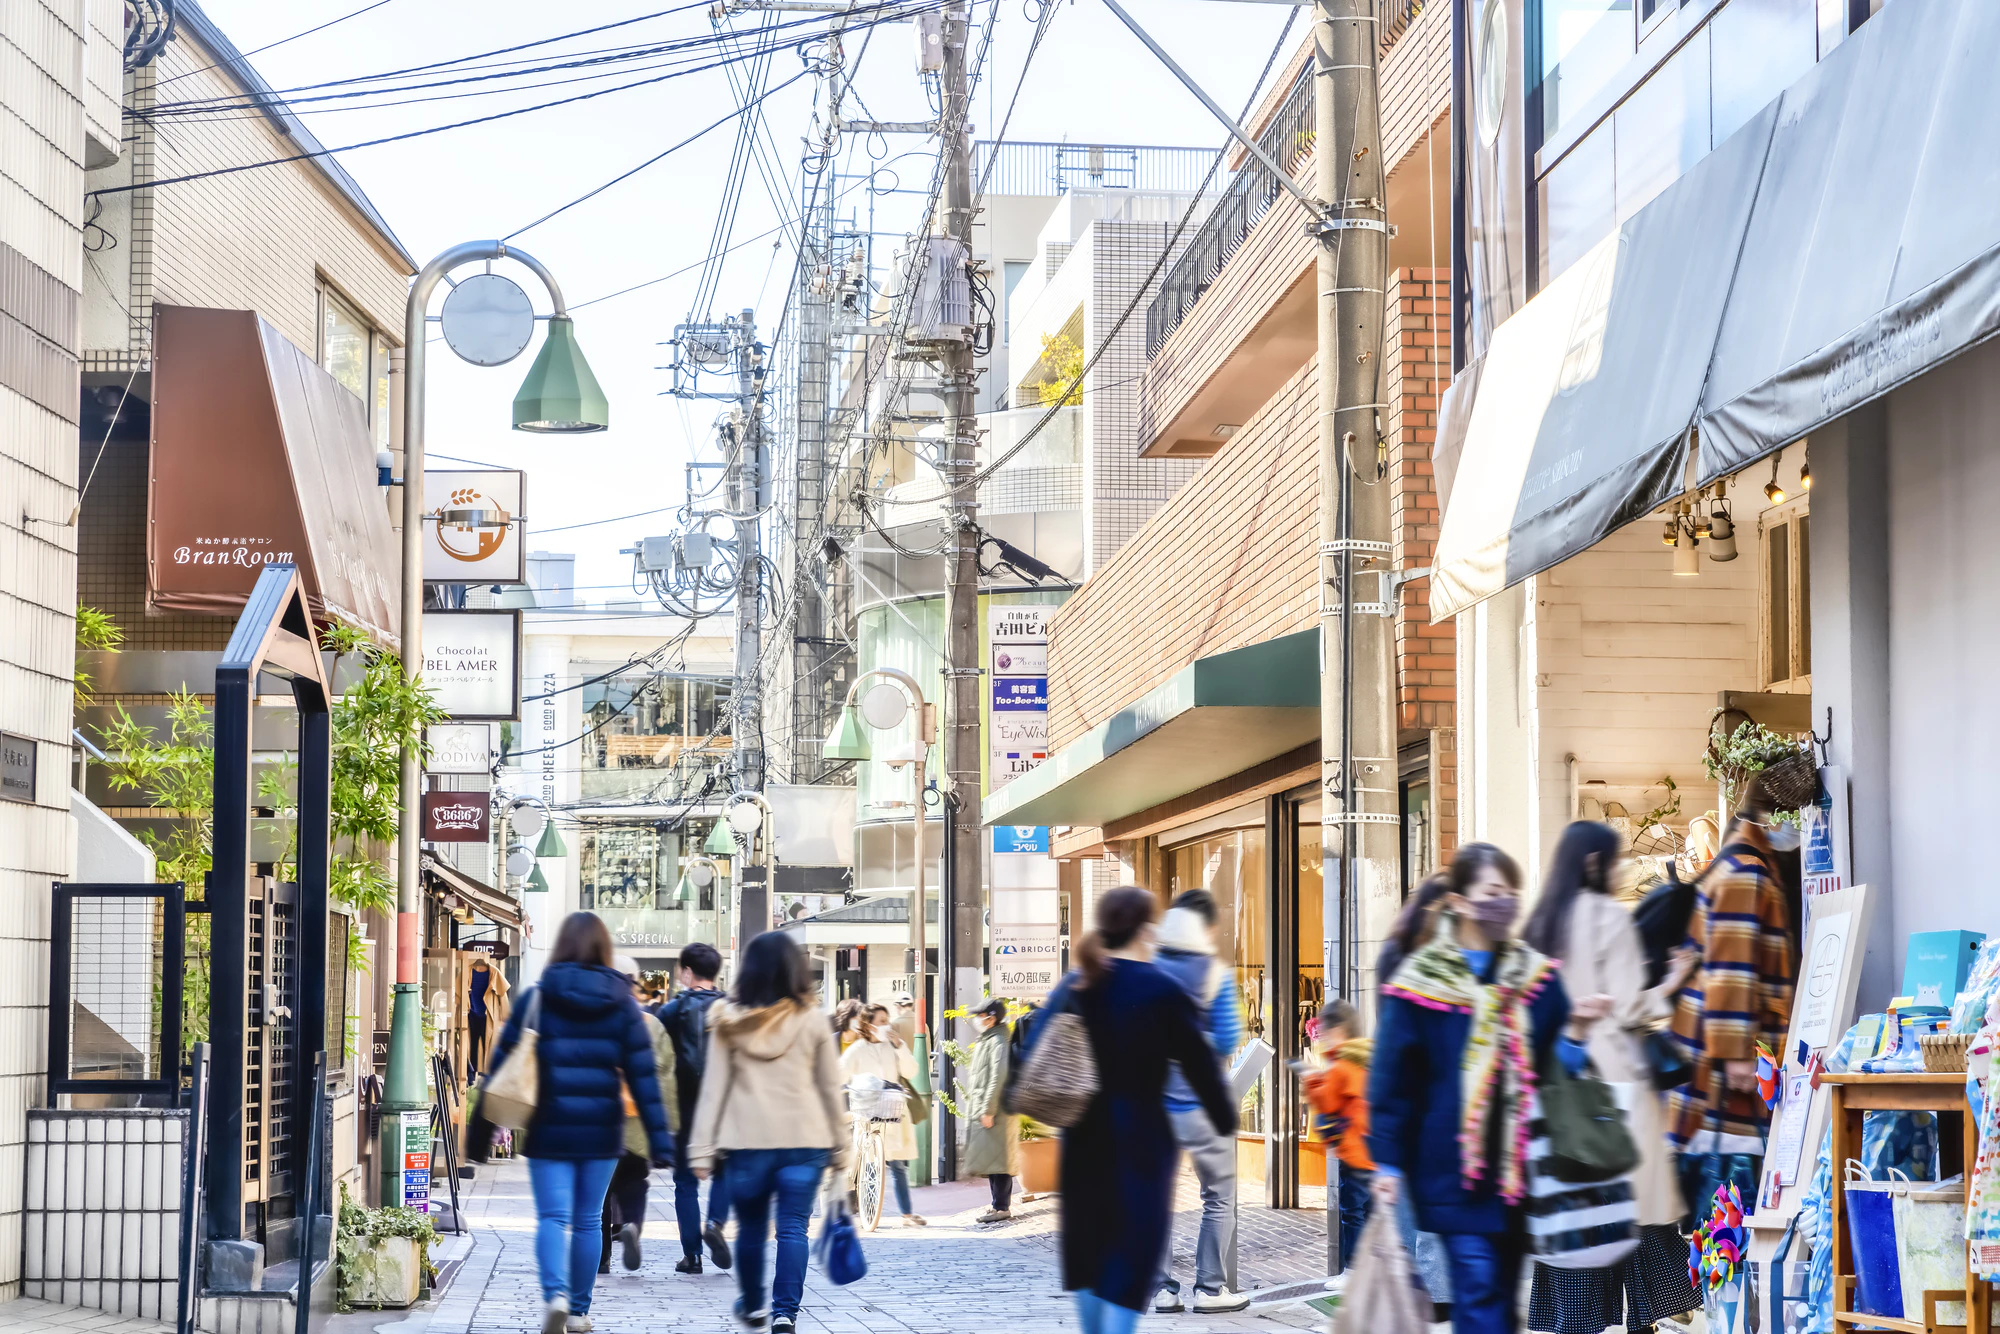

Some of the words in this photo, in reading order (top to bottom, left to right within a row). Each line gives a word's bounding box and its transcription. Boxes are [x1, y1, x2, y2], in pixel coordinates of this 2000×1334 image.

[173, 546, 294, 568] BranRoom
[1008, 611, 1040, 620] 自由が丘
[437, 646, 488, 655] Chocolat
[427, 660, 452, 671] BEL
[456, 660, 498, 671] AMER
[544, 673, 555, 706] PIZZA
[543, 709, 555, 730] GOOD
[430, 751, 487, 763] GODIVA
[543, 738, 555, 781] CHEESE
[443, 810, 471, 821] 8686
[630, 933, 676, 944] SPECIAL
[1001, 972, 1051, 984] 私の部屋
